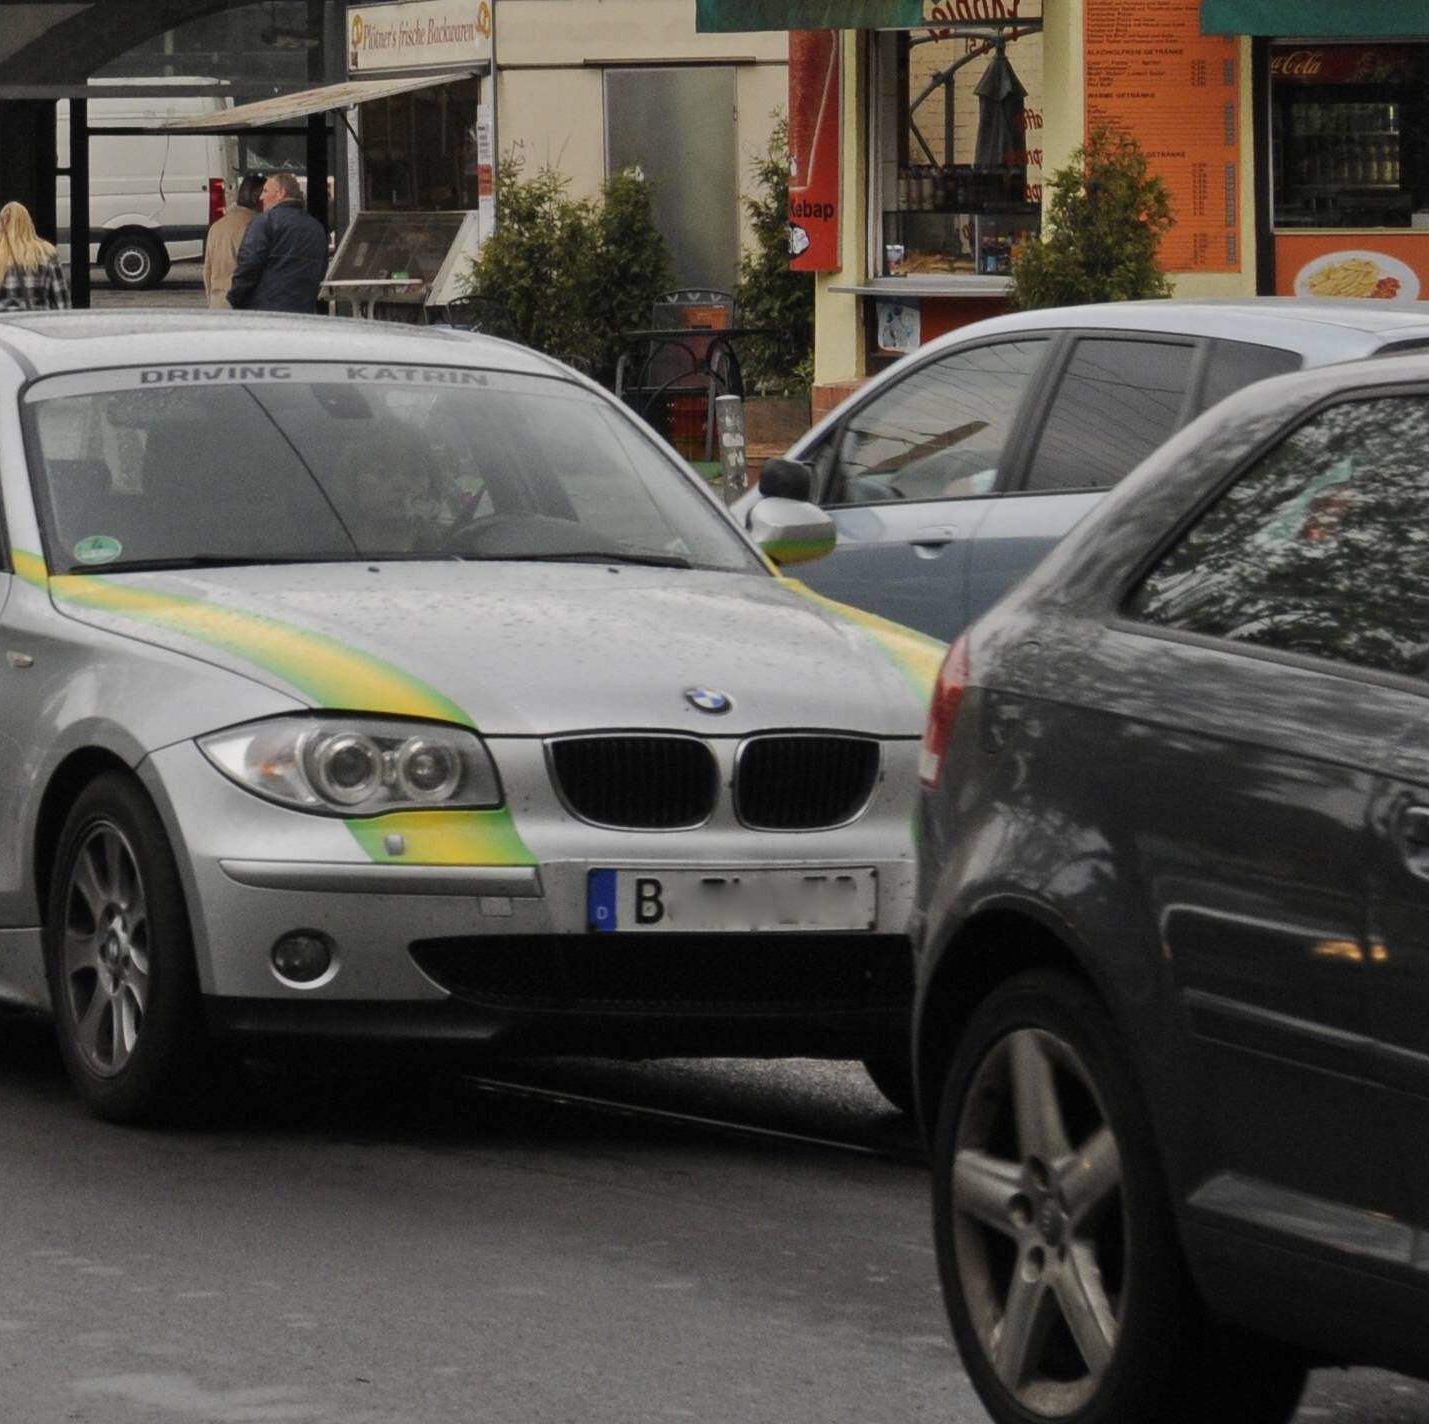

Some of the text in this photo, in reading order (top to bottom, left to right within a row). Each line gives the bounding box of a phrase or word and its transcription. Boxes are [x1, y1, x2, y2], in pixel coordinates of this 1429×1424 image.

[140, 366, 292, 384] DRIVING
[345, 366, 489, 386] KATRIN
[635, 877, 665, 925] B
